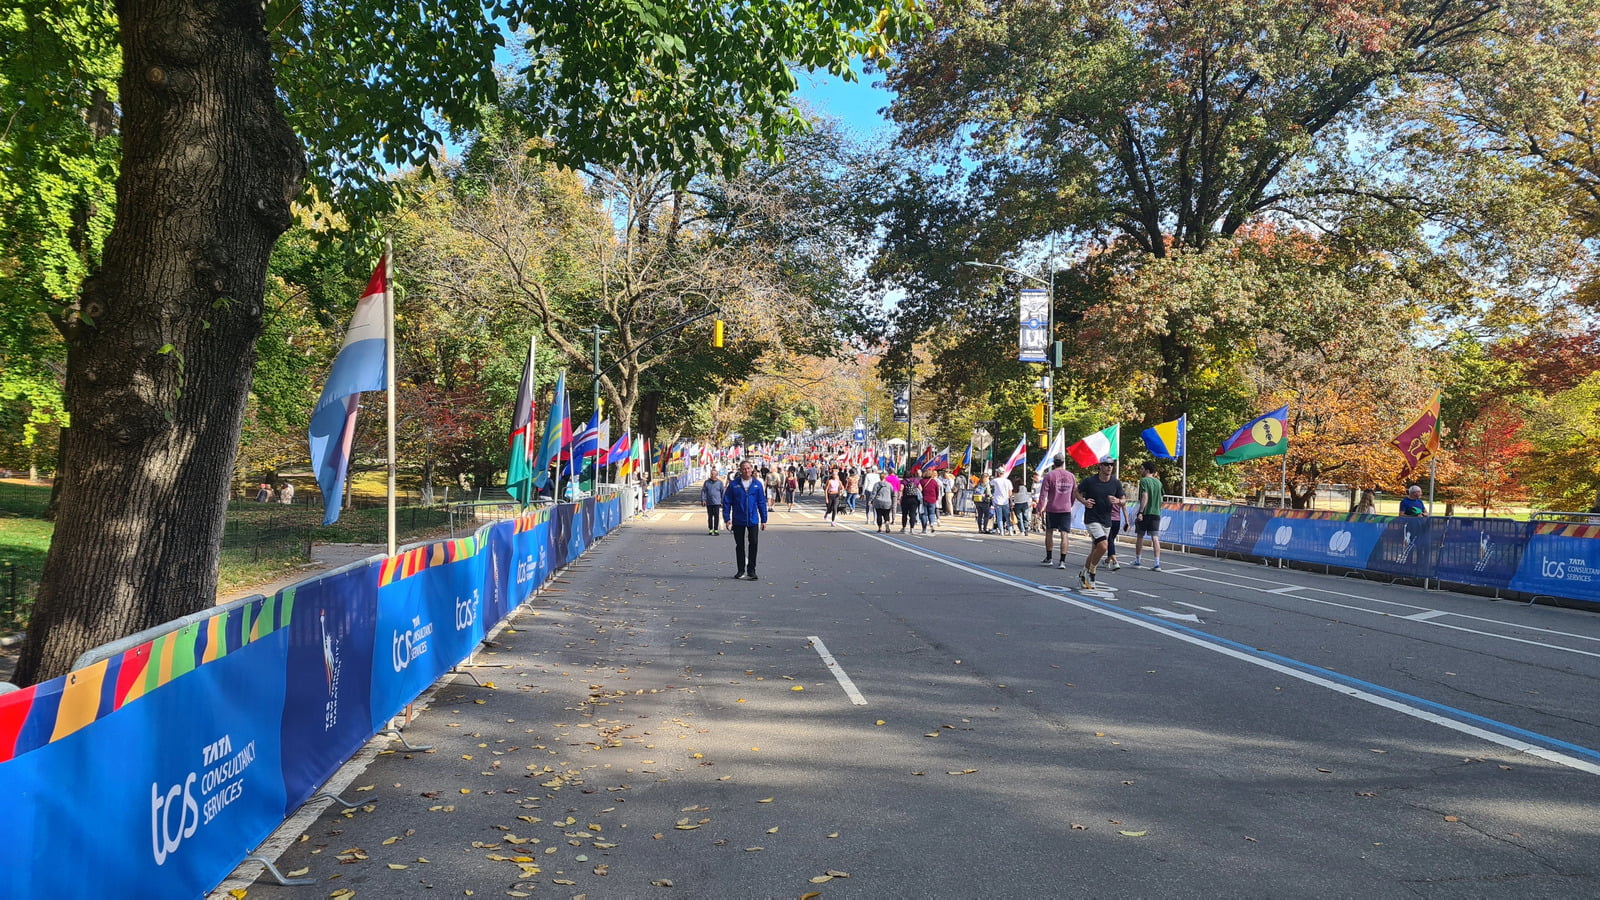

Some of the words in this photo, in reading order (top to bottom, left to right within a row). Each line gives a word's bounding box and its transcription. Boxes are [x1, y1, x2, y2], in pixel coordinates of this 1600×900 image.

[1542, 556, 1565, 579] tcs
[1569, 558, 1586, 566] TATA
[456, 596, 473, 631] tcs
[393, 629, 412, 672] tcs
[201, 739, 256, 796] CONSULTANCY
[202, 734, 232, 767] TATA
[152, 772, 198, 866] tcs
[203, 778, 244, 825] SERVICES
